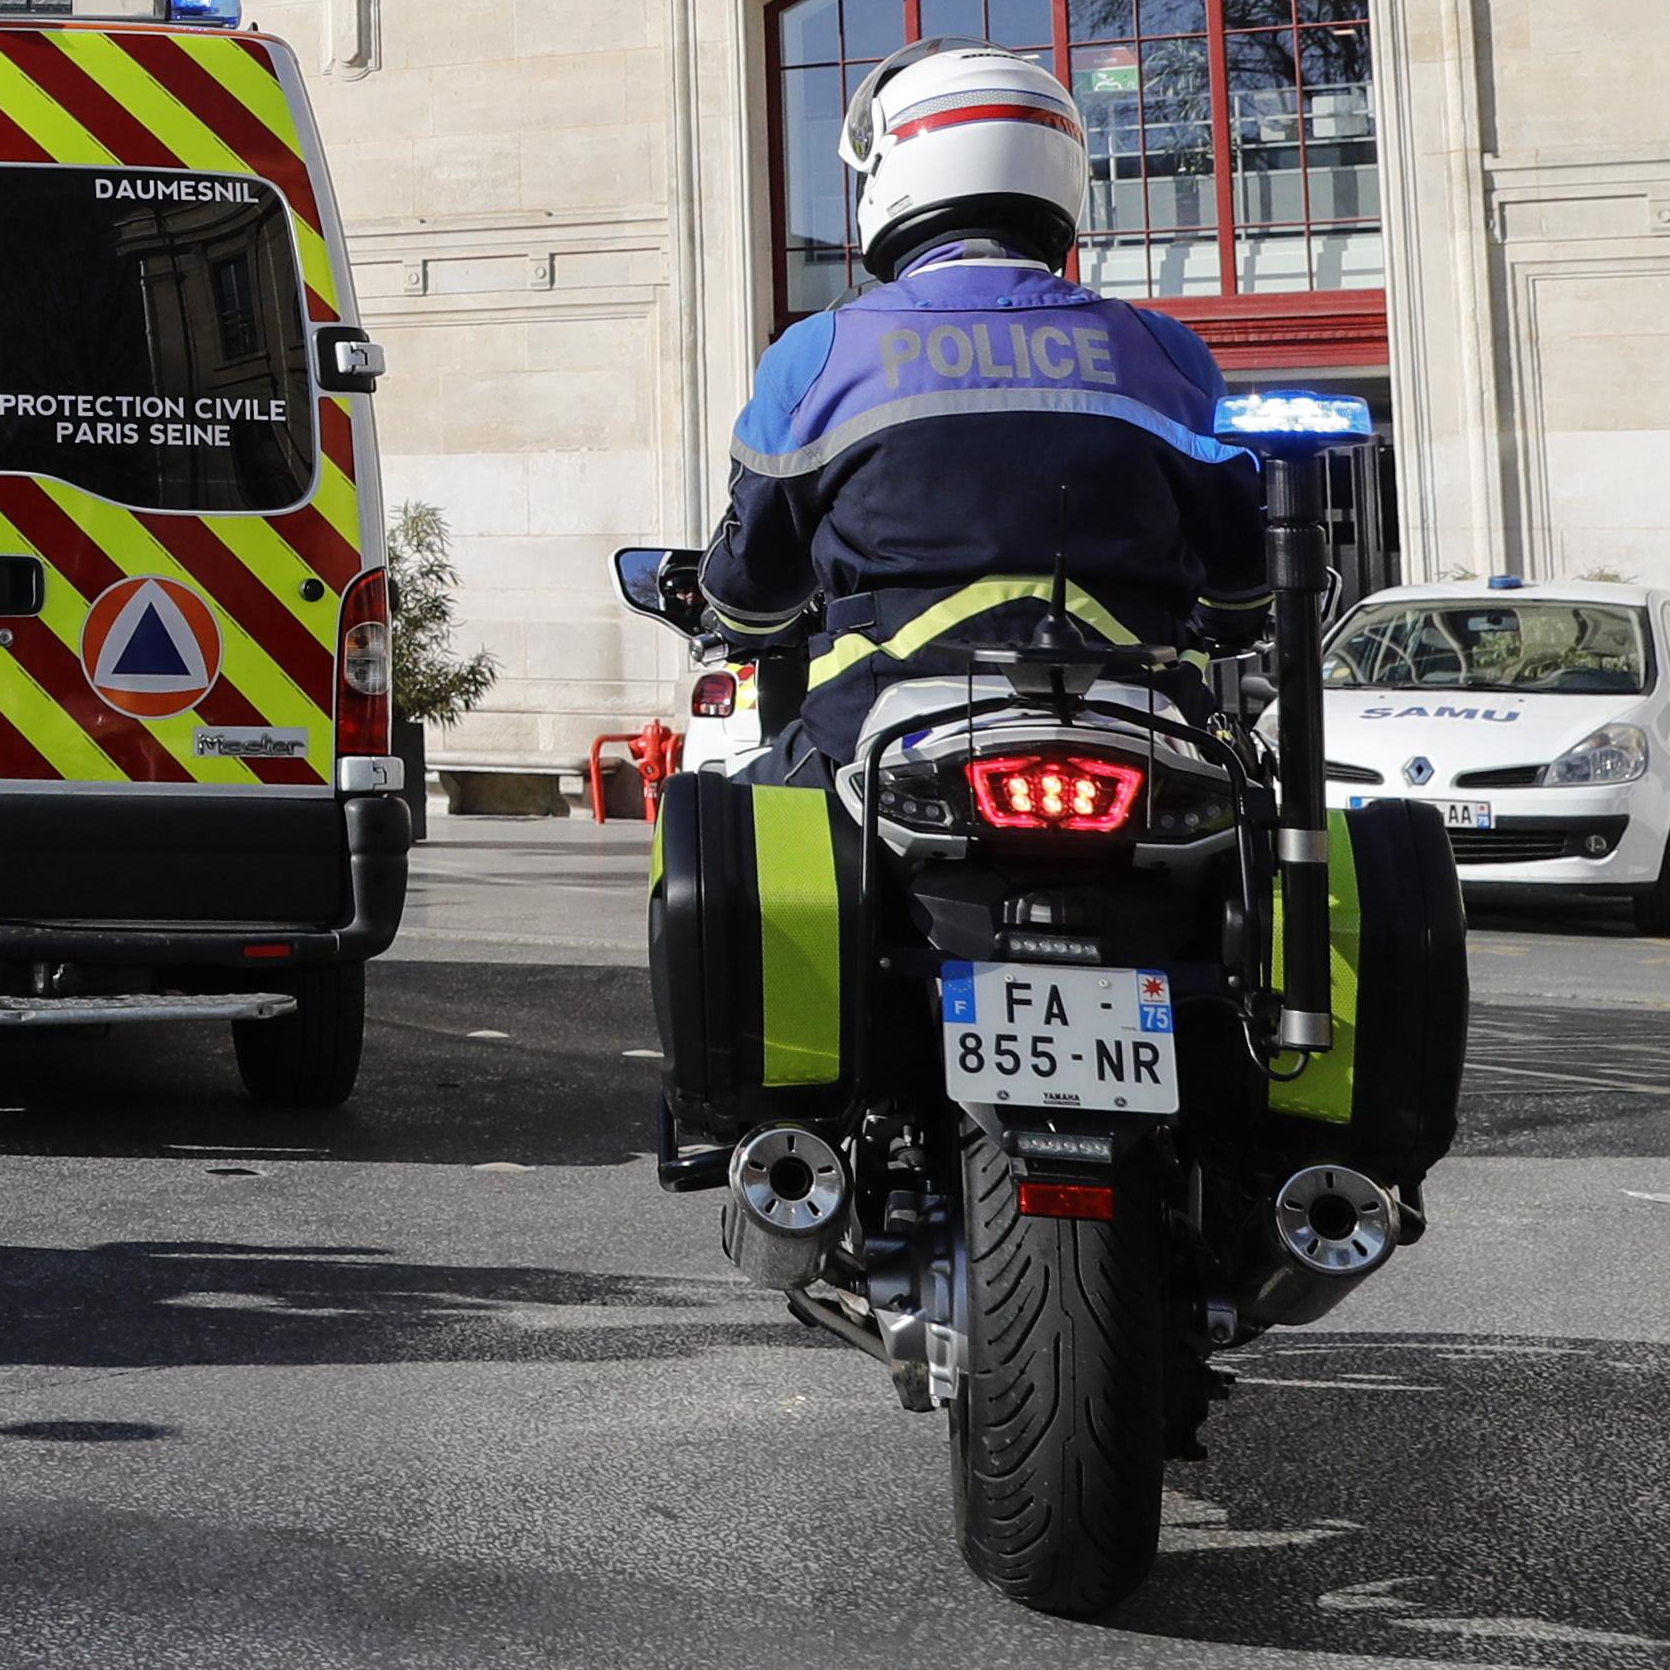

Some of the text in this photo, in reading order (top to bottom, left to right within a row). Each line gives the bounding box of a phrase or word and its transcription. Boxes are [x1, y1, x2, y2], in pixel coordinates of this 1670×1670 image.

[94, 178, 259, 203] DAUMESNIL
[879, 324, 1116, 388] POLICE
[0, 394, 287, 422] PROTECTION CIVILE
[57, 422, 231, 447] PARIS SEINE
[1361, 706, 1521, 722] SAMU
[954, 1000, 967, 1015] F
[1142, 1006, 1169, 1029] 75
[958, 1032, 1162, 1085] 855-NR
[1043, 1091, 1081, 1102] YAMAHA
